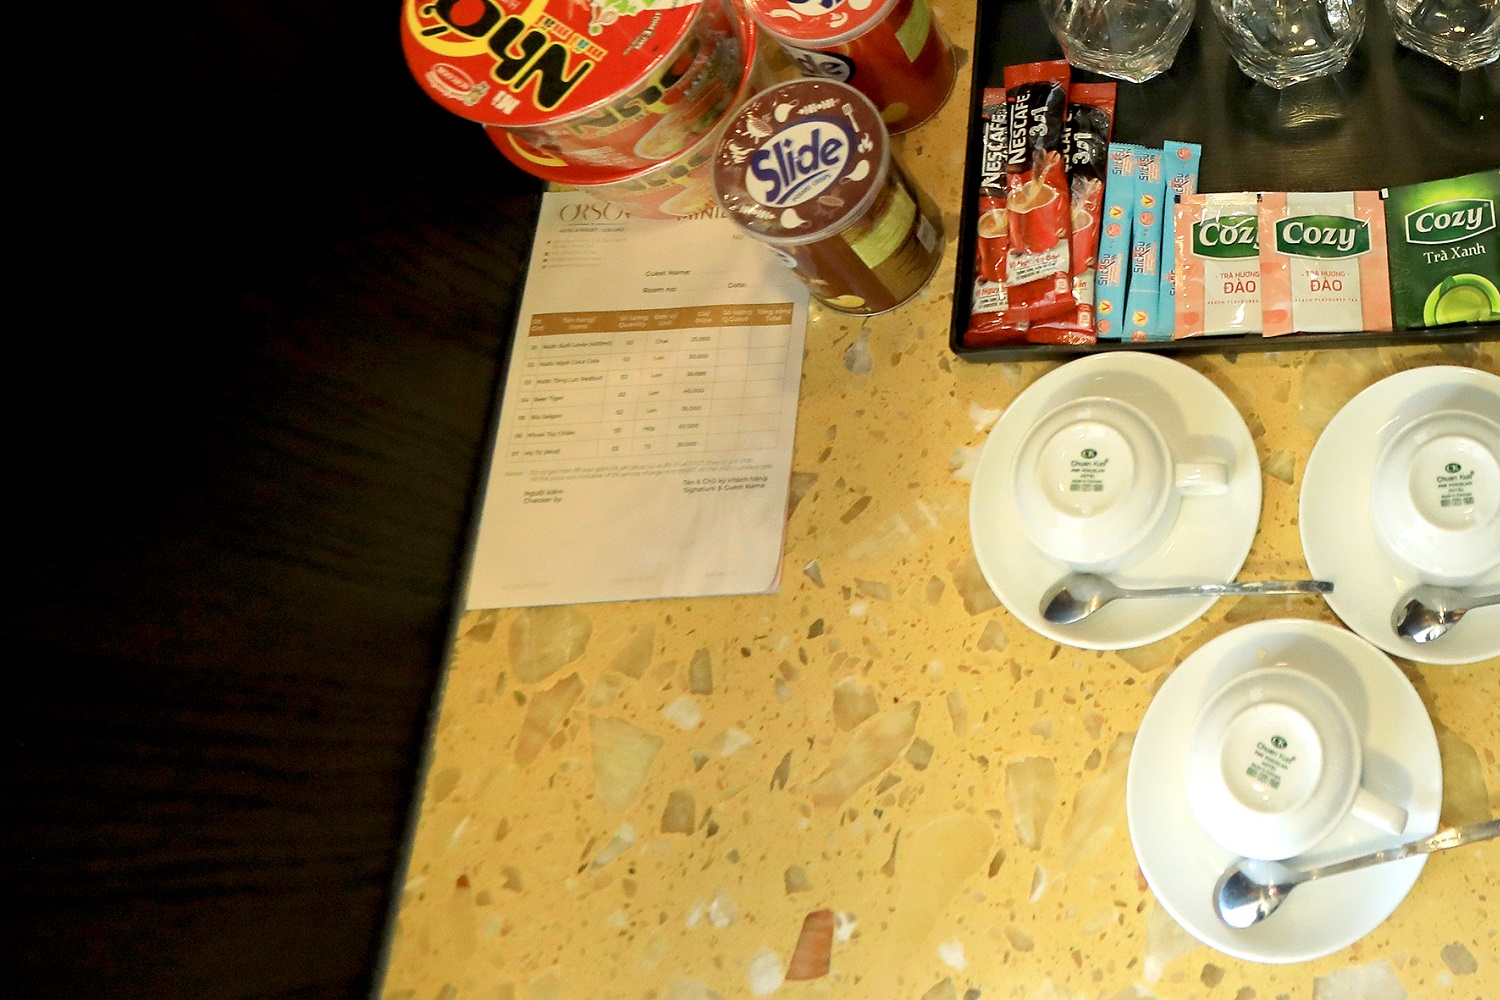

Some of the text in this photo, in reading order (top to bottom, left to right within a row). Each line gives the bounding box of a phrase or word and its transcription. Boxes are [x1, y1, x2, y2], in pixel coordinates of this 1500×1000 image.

[751, 127, 842, 203] Slide
[1415, 206, 1484, 234] Cozy
[1282, 221, 1357, 252] Cozy
[1423, 242, 1487, 265] Trà Xanh
[1223, 276, 1257, 295] ĐÀO
[1310, 276, 1344, 293] ĐÀO
